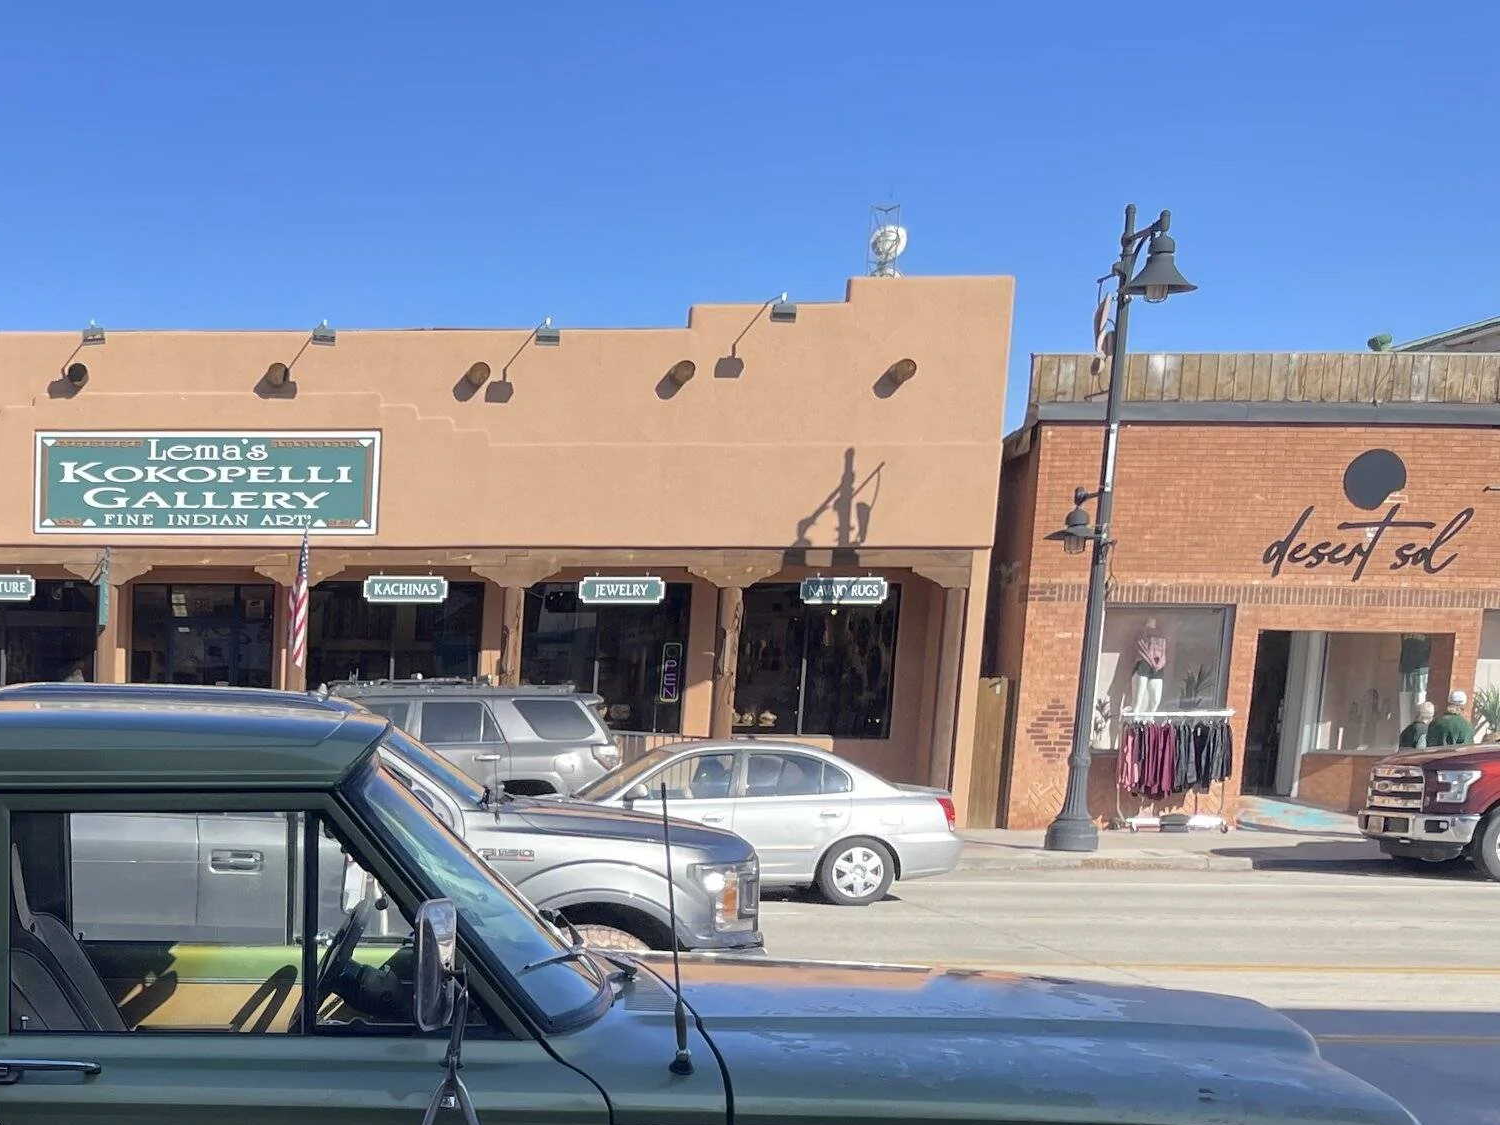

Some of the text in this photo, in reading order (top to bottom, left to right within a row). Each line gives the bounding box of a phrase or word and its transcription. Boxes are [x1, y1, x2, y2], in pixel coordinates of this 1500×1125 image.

[147, 438, 269, 461] Lema's
[59, 461, 353, 483] KOKOPELLI
[82, 487, 330, 509] GALLERY
[104, 513, 154, 526] FINE
[167, 514, 247, 527] INDIAN
[1262, 503, 1475, 583] desert sol
[373, 583, 438, 596] KACHINAS
[595, 583, 649, 597] JEWELRY
[808, 584, 879, 598] NAVAJO RUGS
[663, 646, 679, 699] OPEN
